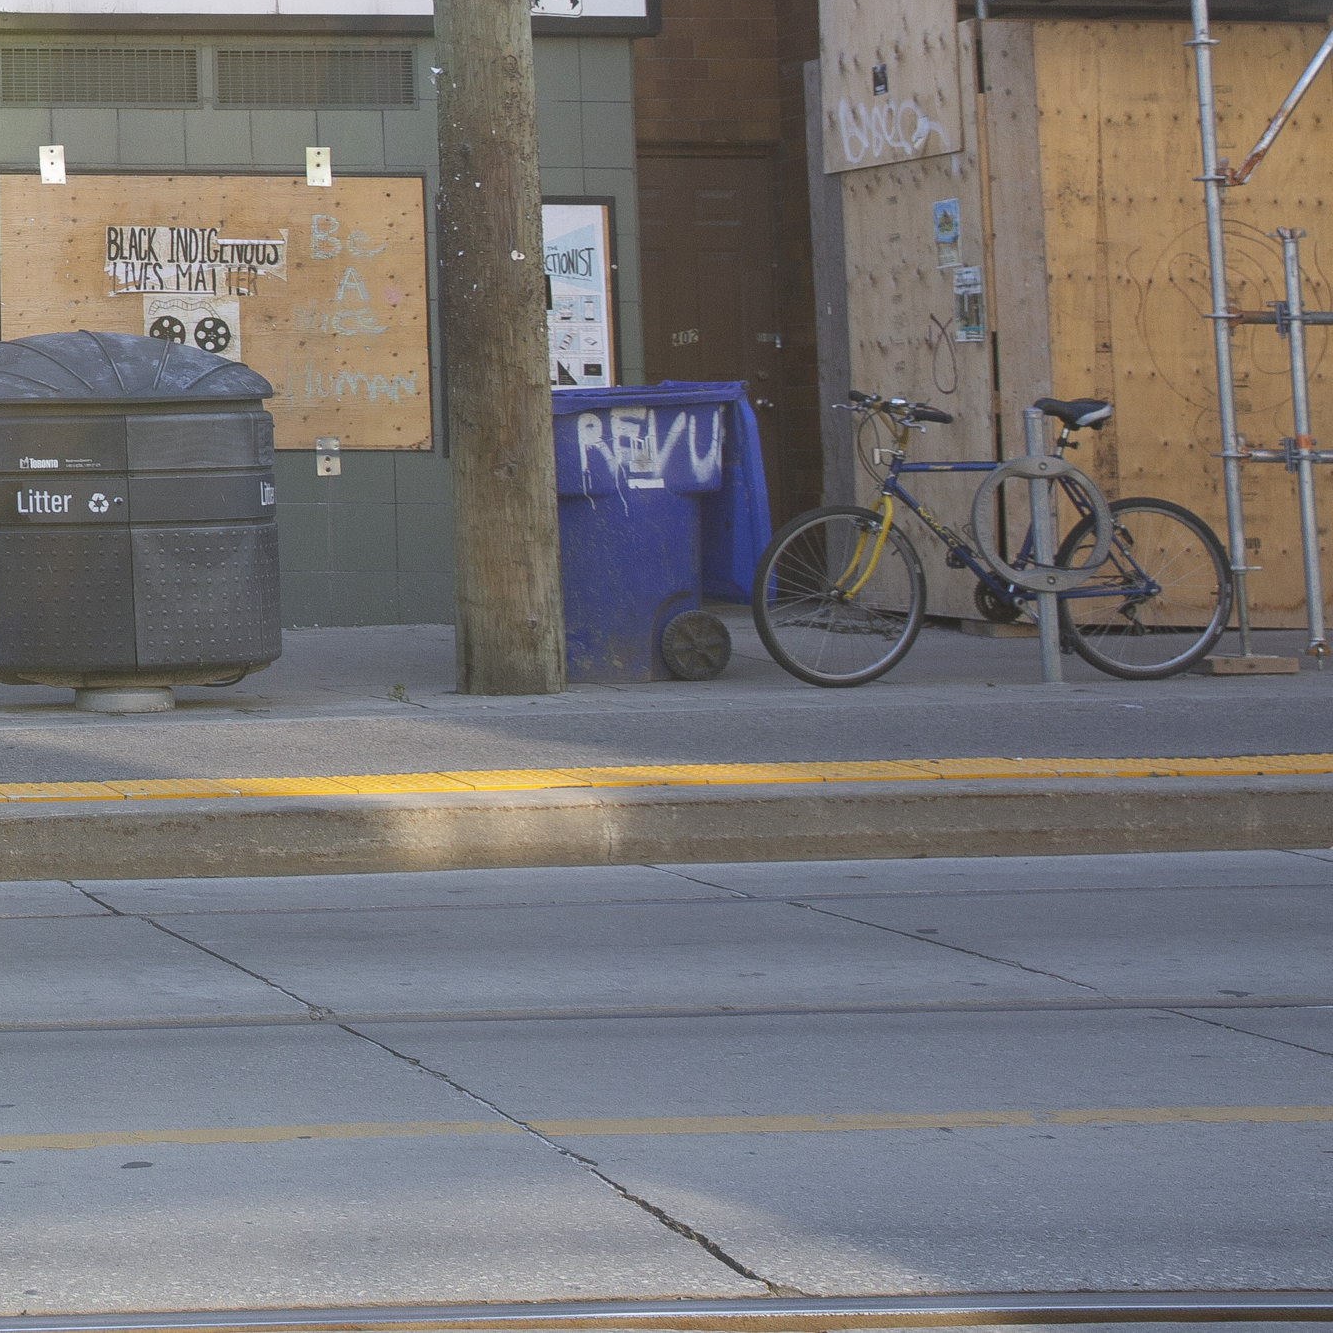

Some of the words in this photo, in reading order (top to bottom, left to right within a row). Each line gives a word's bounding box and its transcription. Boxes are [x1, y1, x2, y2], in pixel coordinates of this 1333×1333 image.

[107, 227, 159, 261] BLACK
[310, 214, 386, 260] Be
[544, 247, 595, 277] CTIONIST
[335, 267, 370, 301] A
[29, 458, 59, 469] TORONTO
[17, 490, 72, 513] Litter
